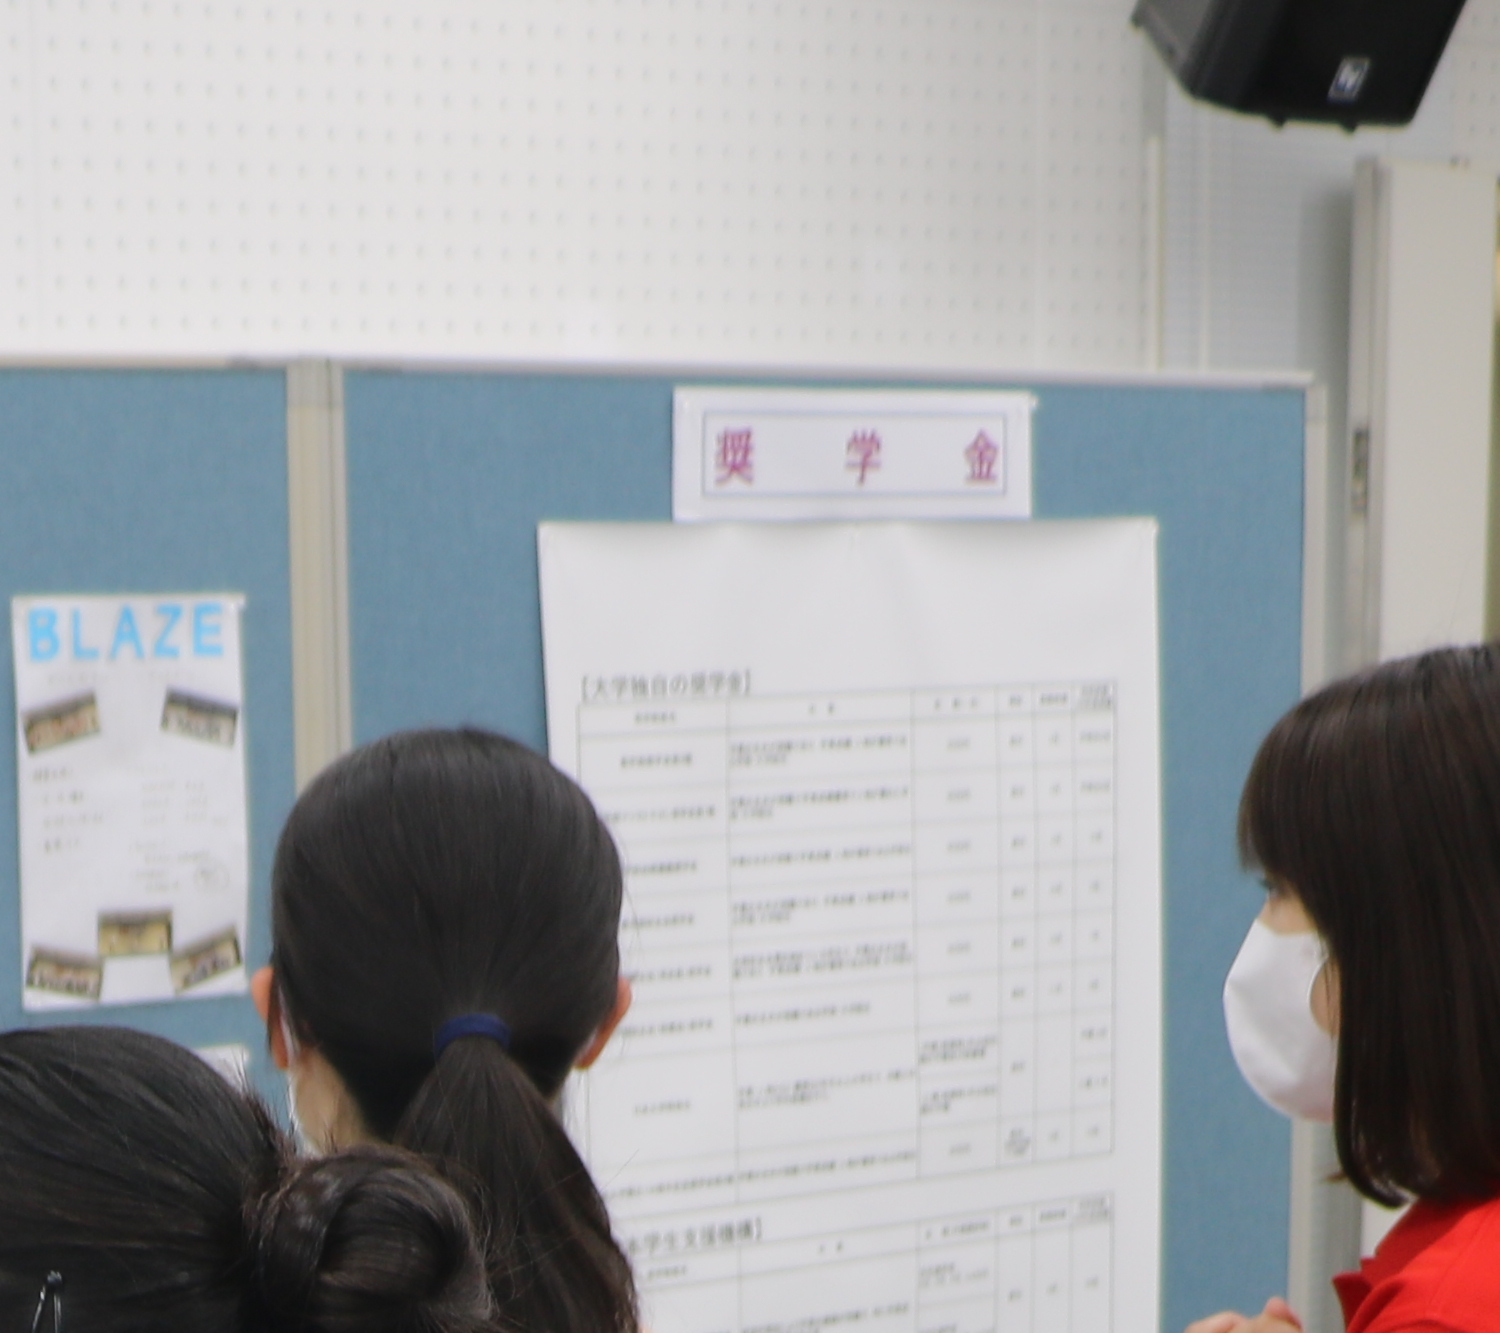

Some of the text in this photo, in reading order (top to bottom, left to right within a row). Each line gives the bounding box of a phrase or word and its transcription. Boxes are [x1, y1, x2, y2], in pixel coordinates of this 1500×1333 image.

[714, 427, 998, 486] 奨学金
[27, 601, 225, 662] BLAZE
[627, 1204, 763, 1254] 本学生支援機構】
